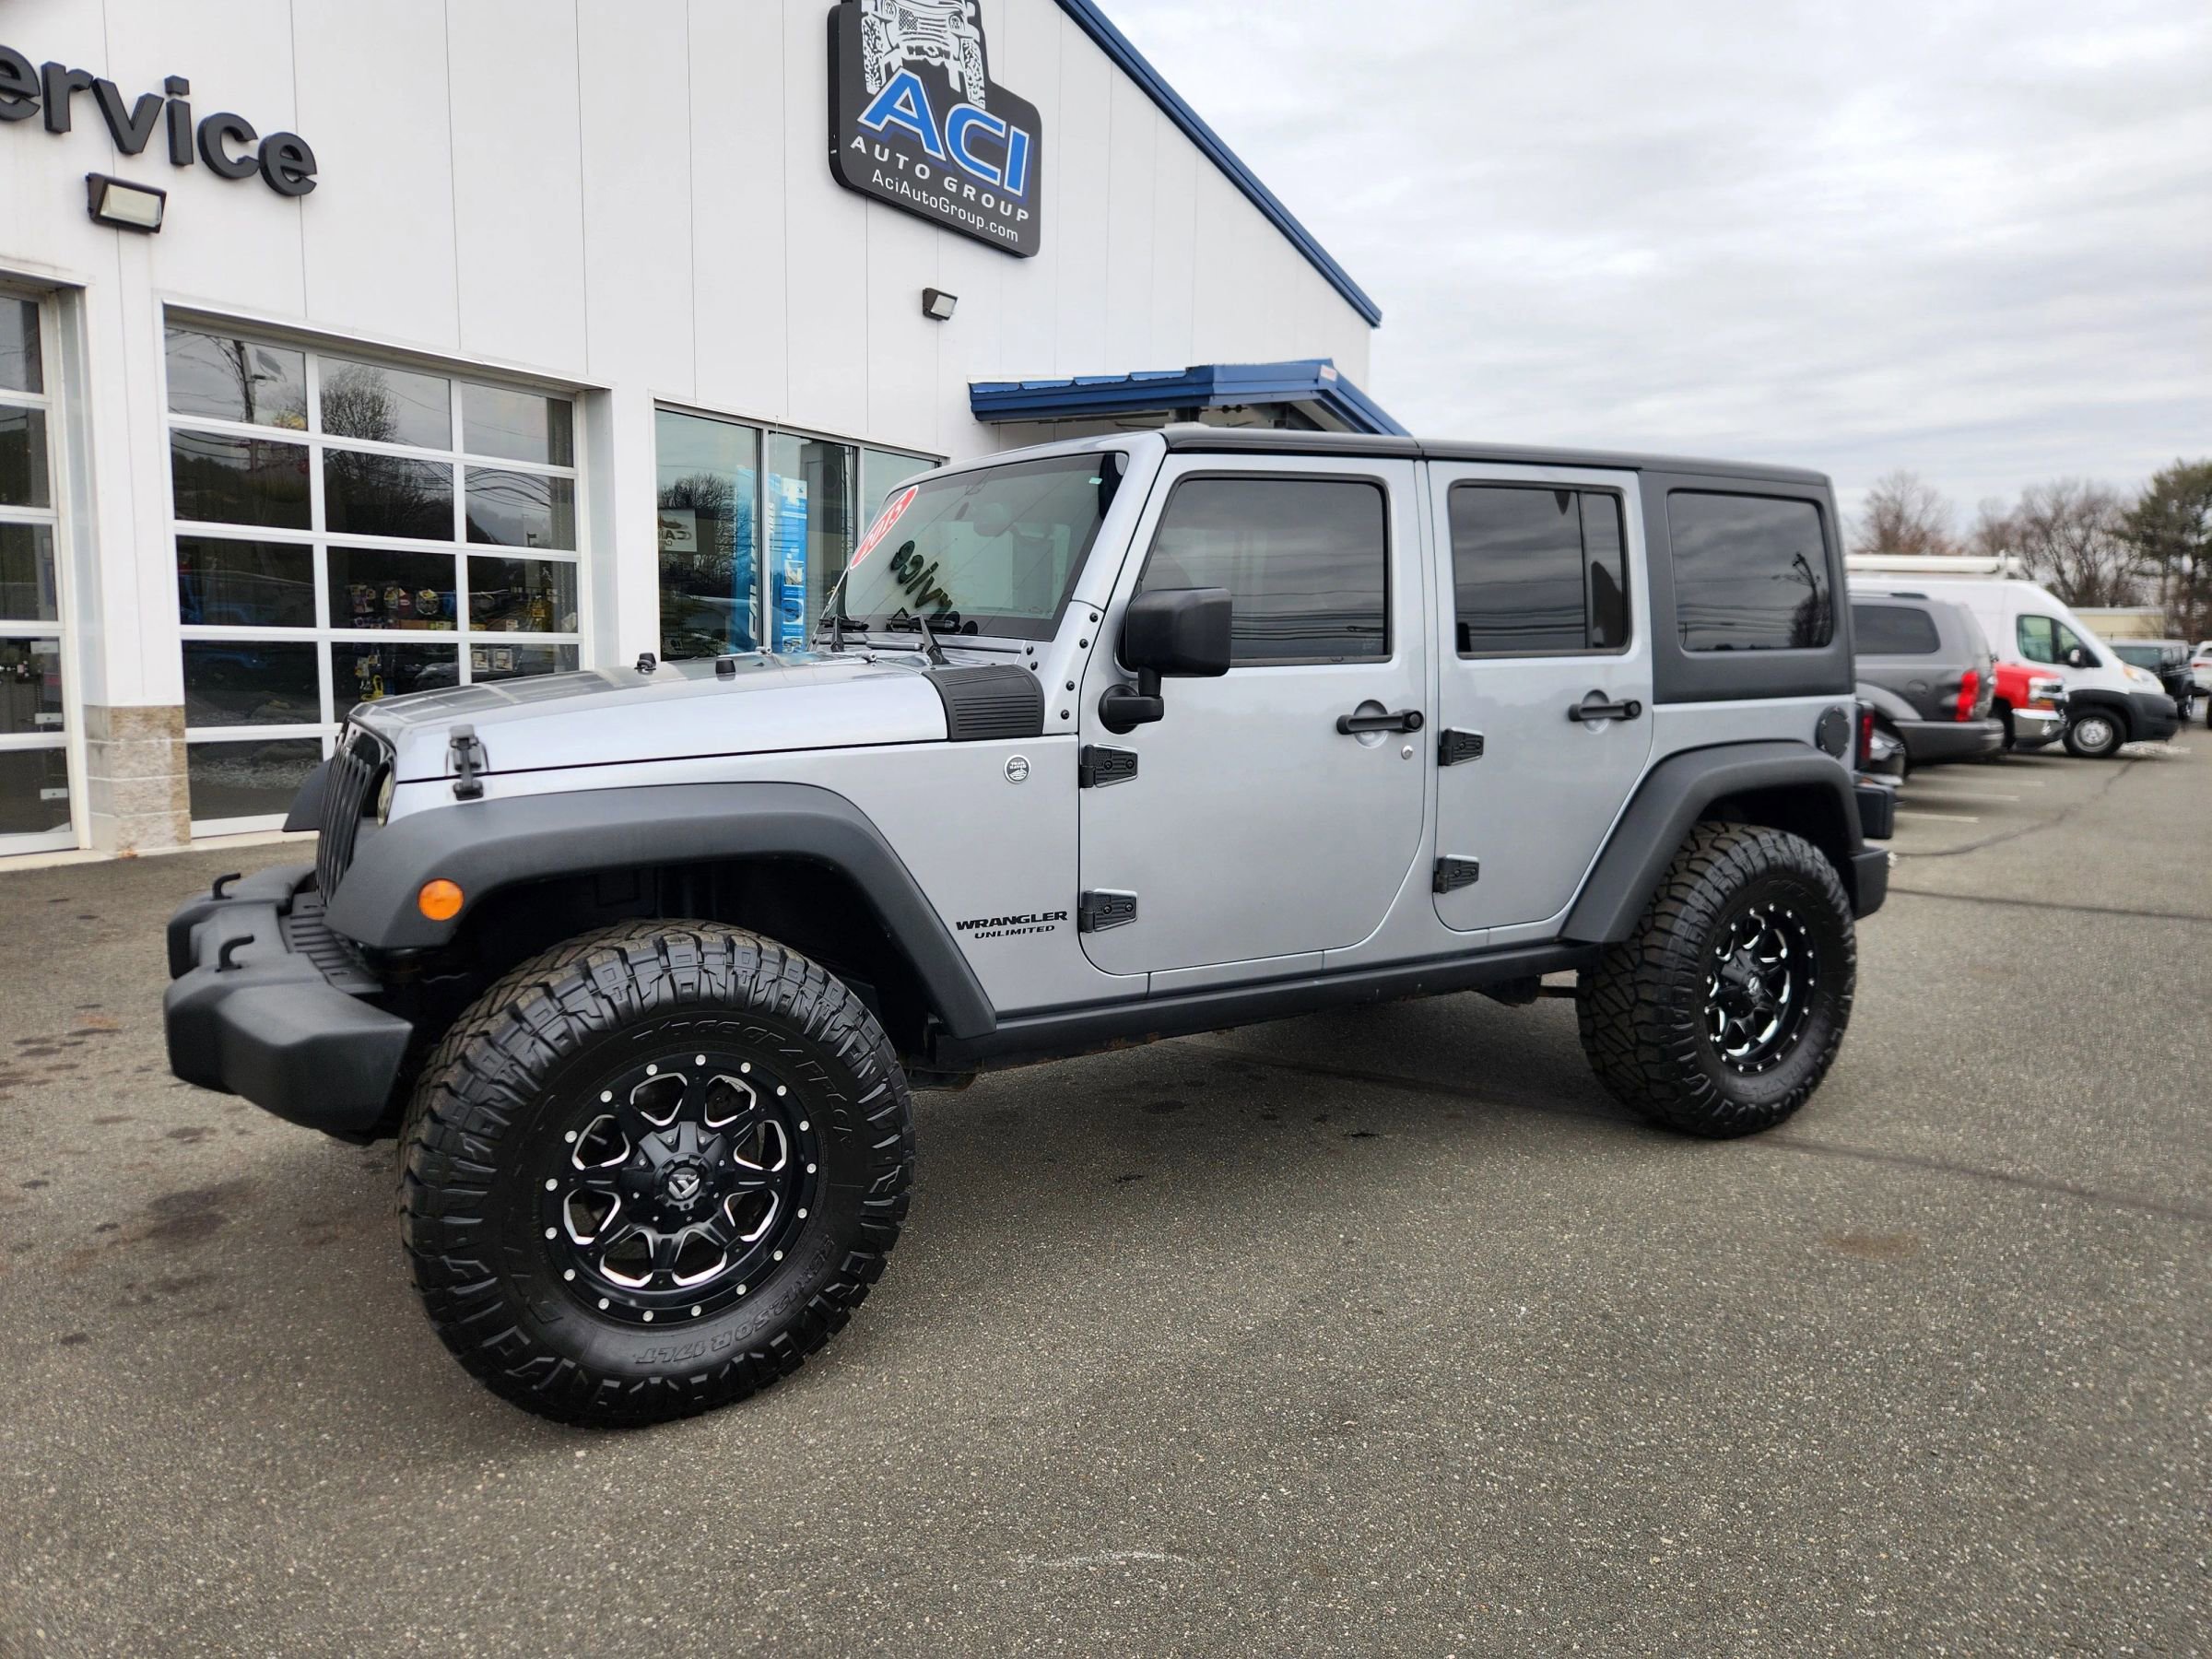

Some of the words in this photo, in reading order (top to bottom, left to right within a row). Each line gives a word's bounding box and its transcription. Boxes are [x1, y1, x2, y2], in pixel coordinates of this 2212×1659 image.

[857, 66, 1030, 197] ACI
[850, 135, 931, 180] AUTO
[943, 175, 1030, 222] GROUP
[872, 169, 1019, 242] AciAutoGroup.com
[956, 911, 1068, 930] WRANGLER
[974, 924, 1055, 939] UNLIMITED
